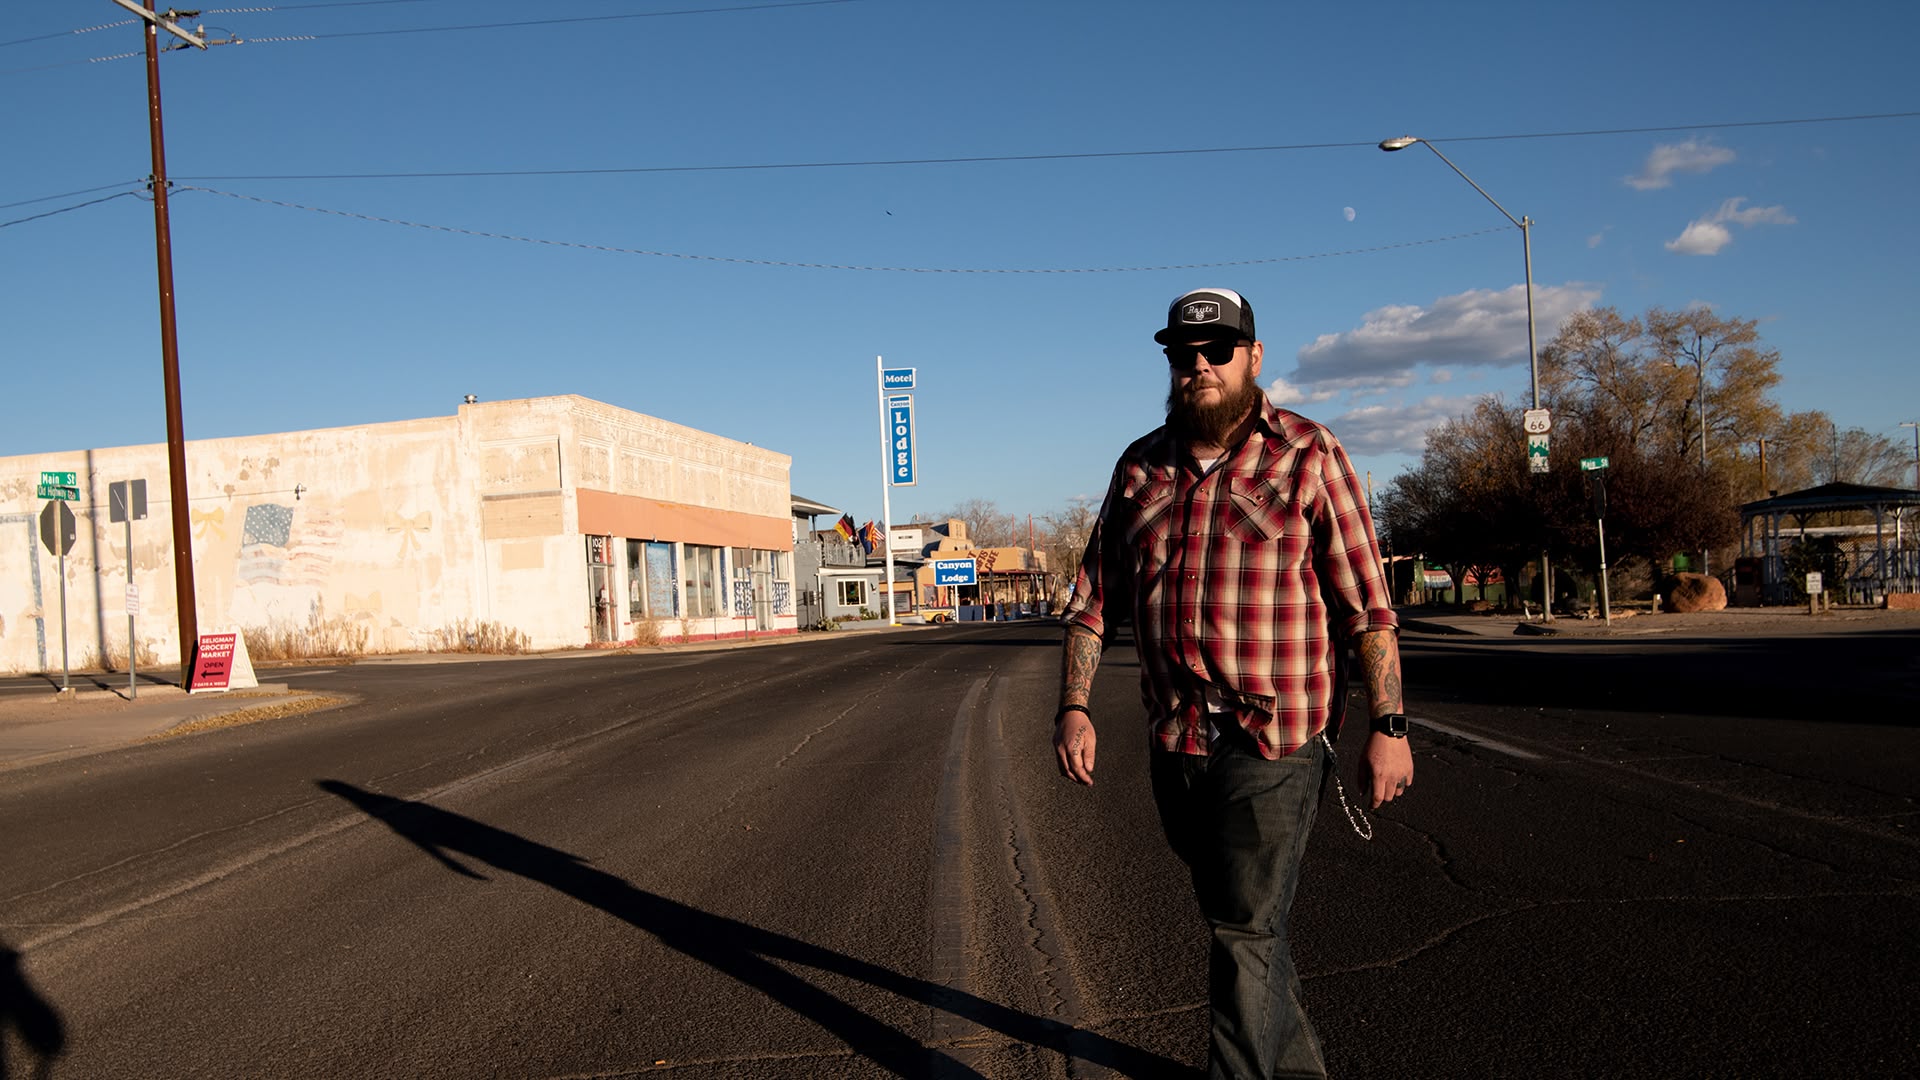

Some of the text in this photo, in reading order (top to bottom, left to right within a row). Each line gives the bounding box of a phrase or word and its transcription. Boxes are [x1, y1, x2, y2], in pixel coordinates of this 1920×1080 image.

[1187, 305, 1213, 314] Route
[885, 374, 912, 383] Motel
[1530, 421, 1545, 430] 66
[895, 411, 908, 477] Lodge
[42, 473, 75, 485] Main St
[38, 486, 46, 496] Old
[48, 486, 66, 500] Highway
[984, 550, 999, 570] CAFE
[936, 562, 972, 571] Canyon
[941, 574, 969, 583] Lodge
[201, 651, 231, 659] MARKET
